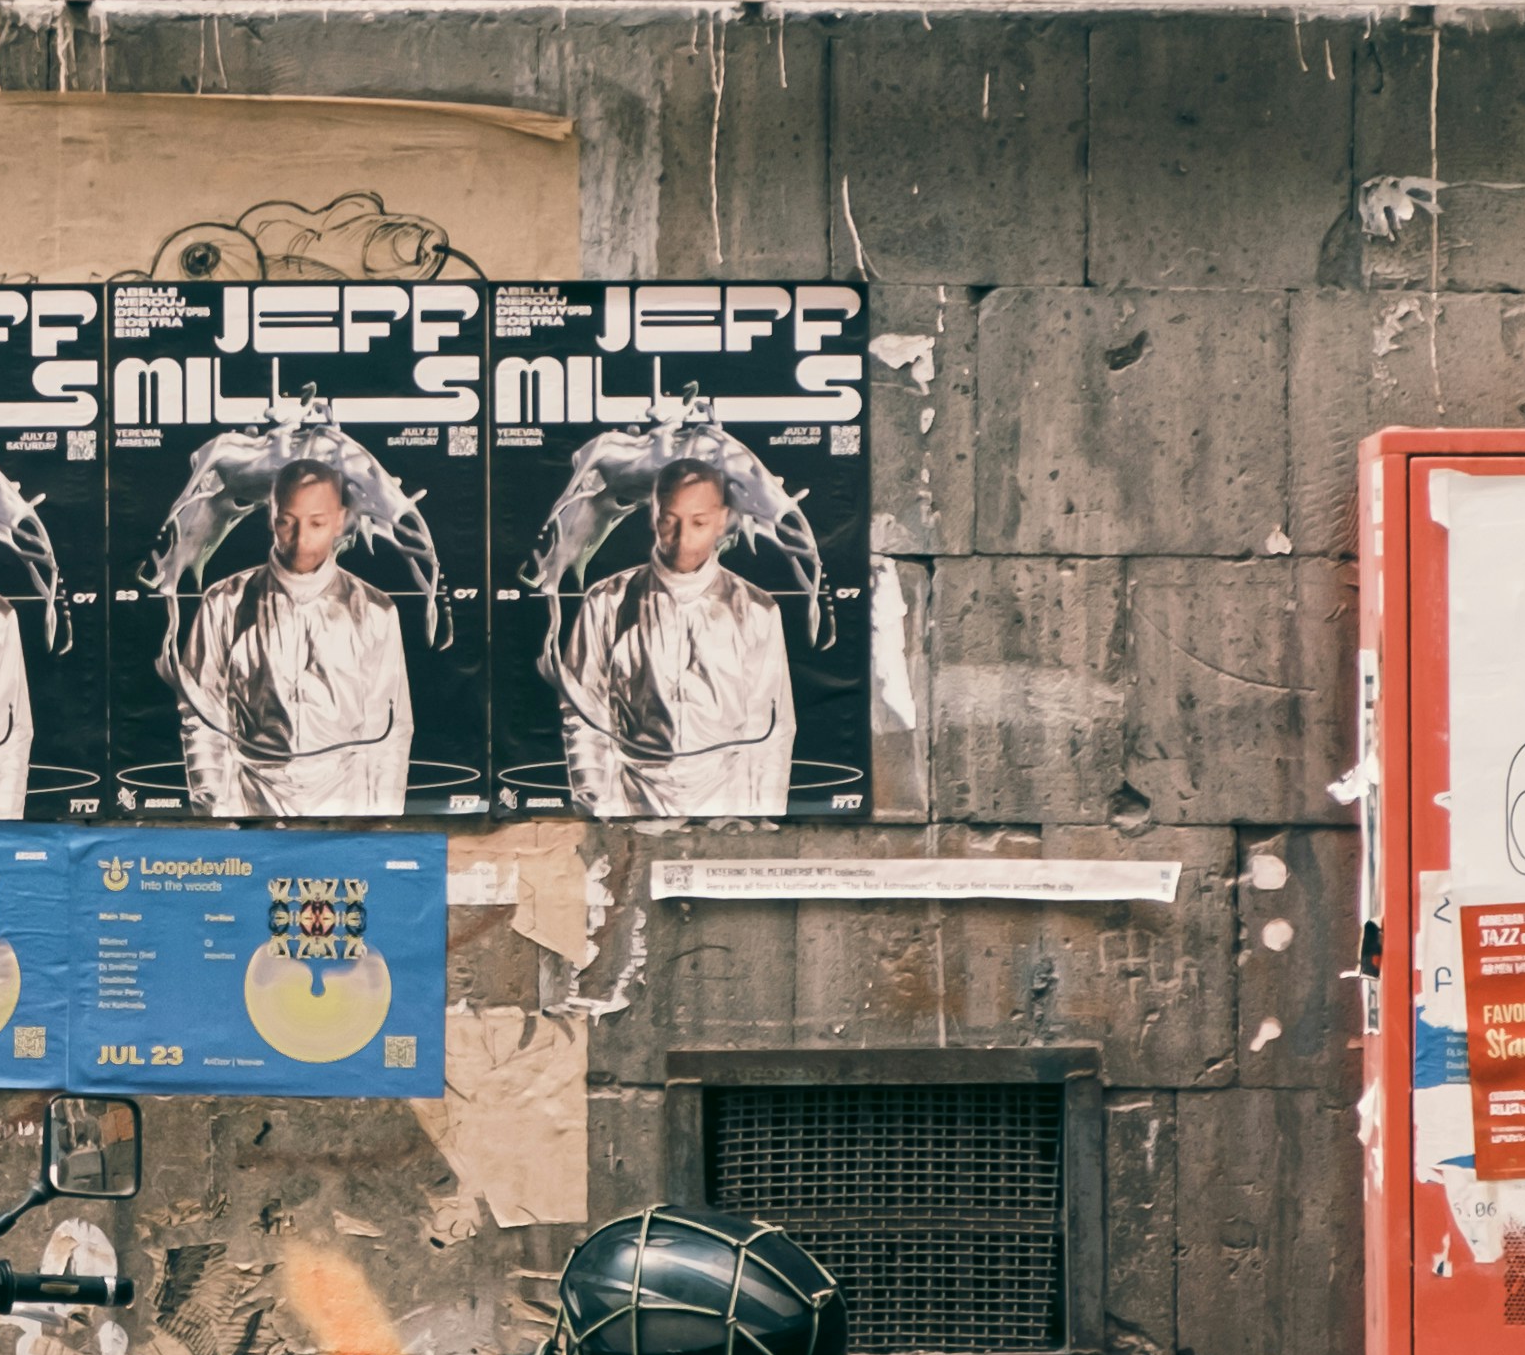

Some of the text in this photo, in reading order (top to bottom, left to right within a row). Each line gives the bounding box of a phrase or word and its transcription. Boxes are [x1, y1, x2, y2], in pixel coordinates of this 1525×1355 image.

[214, 285, 479, 353] JEFF
[596, 286, 861, 352] JEFF
[114, 356, 480, 424] MILLS
[496, 355, 862, 423] MILLS
[140, 858, 253, 879] Loopdeville
[1480, 928, 1520, 947] JAZZ
[97, 1046, 145, 1065] JUL
[151, 1046, 184, 1065] 23
